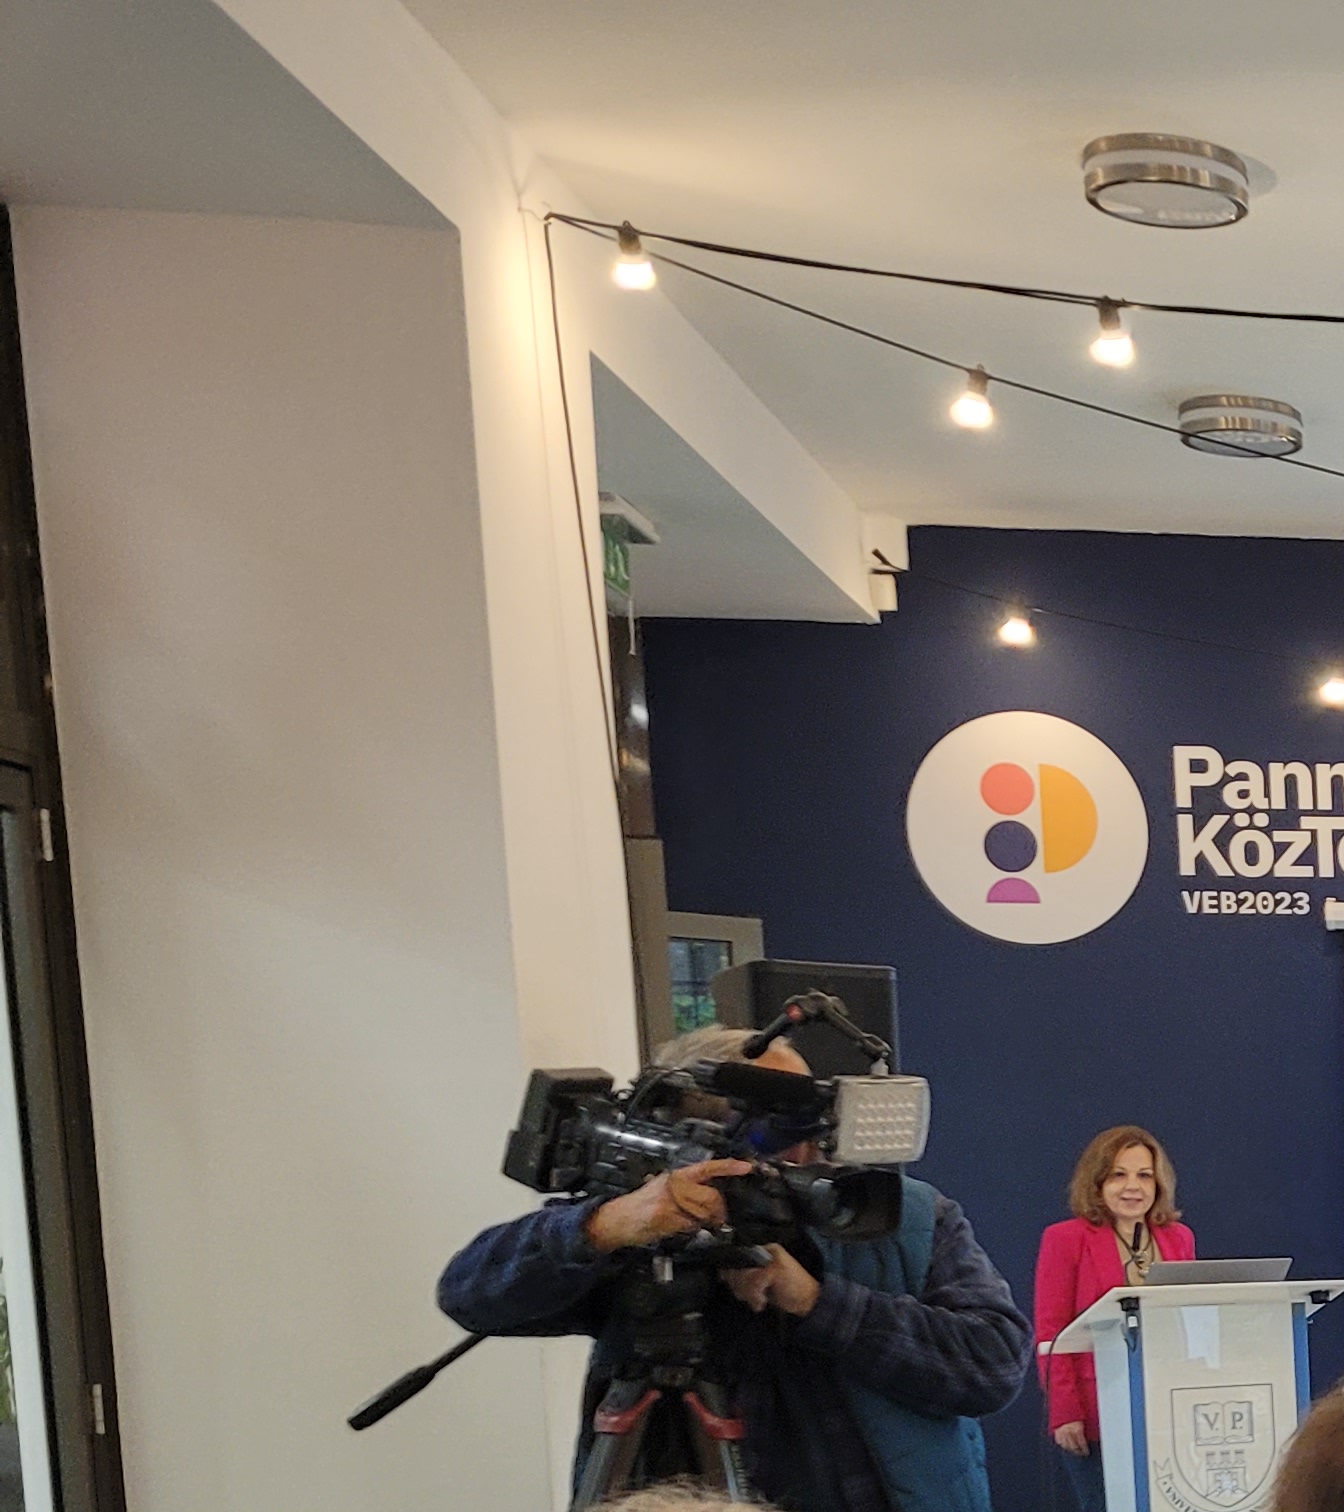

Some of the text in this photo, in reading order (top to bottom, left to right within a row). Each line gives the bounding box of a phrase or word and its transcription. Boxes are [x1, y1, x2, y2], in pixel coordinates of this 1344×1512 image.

[1180, 890, 1310, 915] VEB2023
[1202, 1411, 1244, 1431] V. P.
